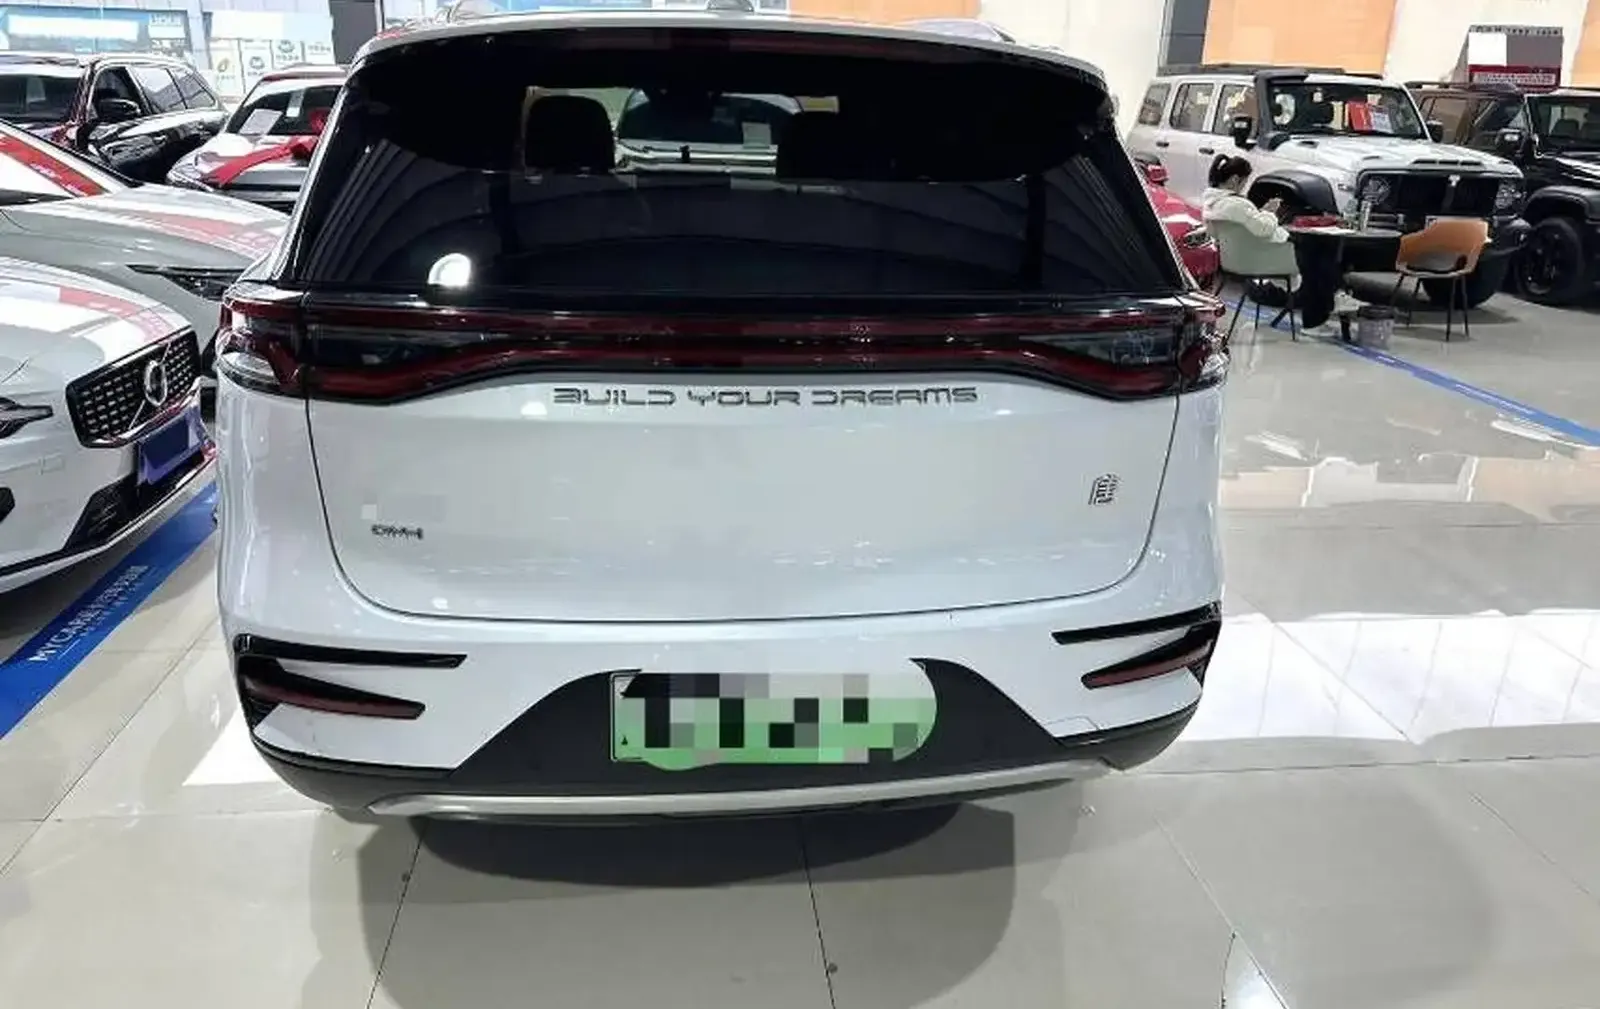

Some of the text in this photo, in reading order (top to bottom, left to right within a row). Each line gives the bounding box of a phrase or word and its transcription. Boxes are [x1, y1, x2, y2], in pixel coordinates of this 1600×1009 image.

[553, 387, 978, 406] BUILD YOUR DREAMS
